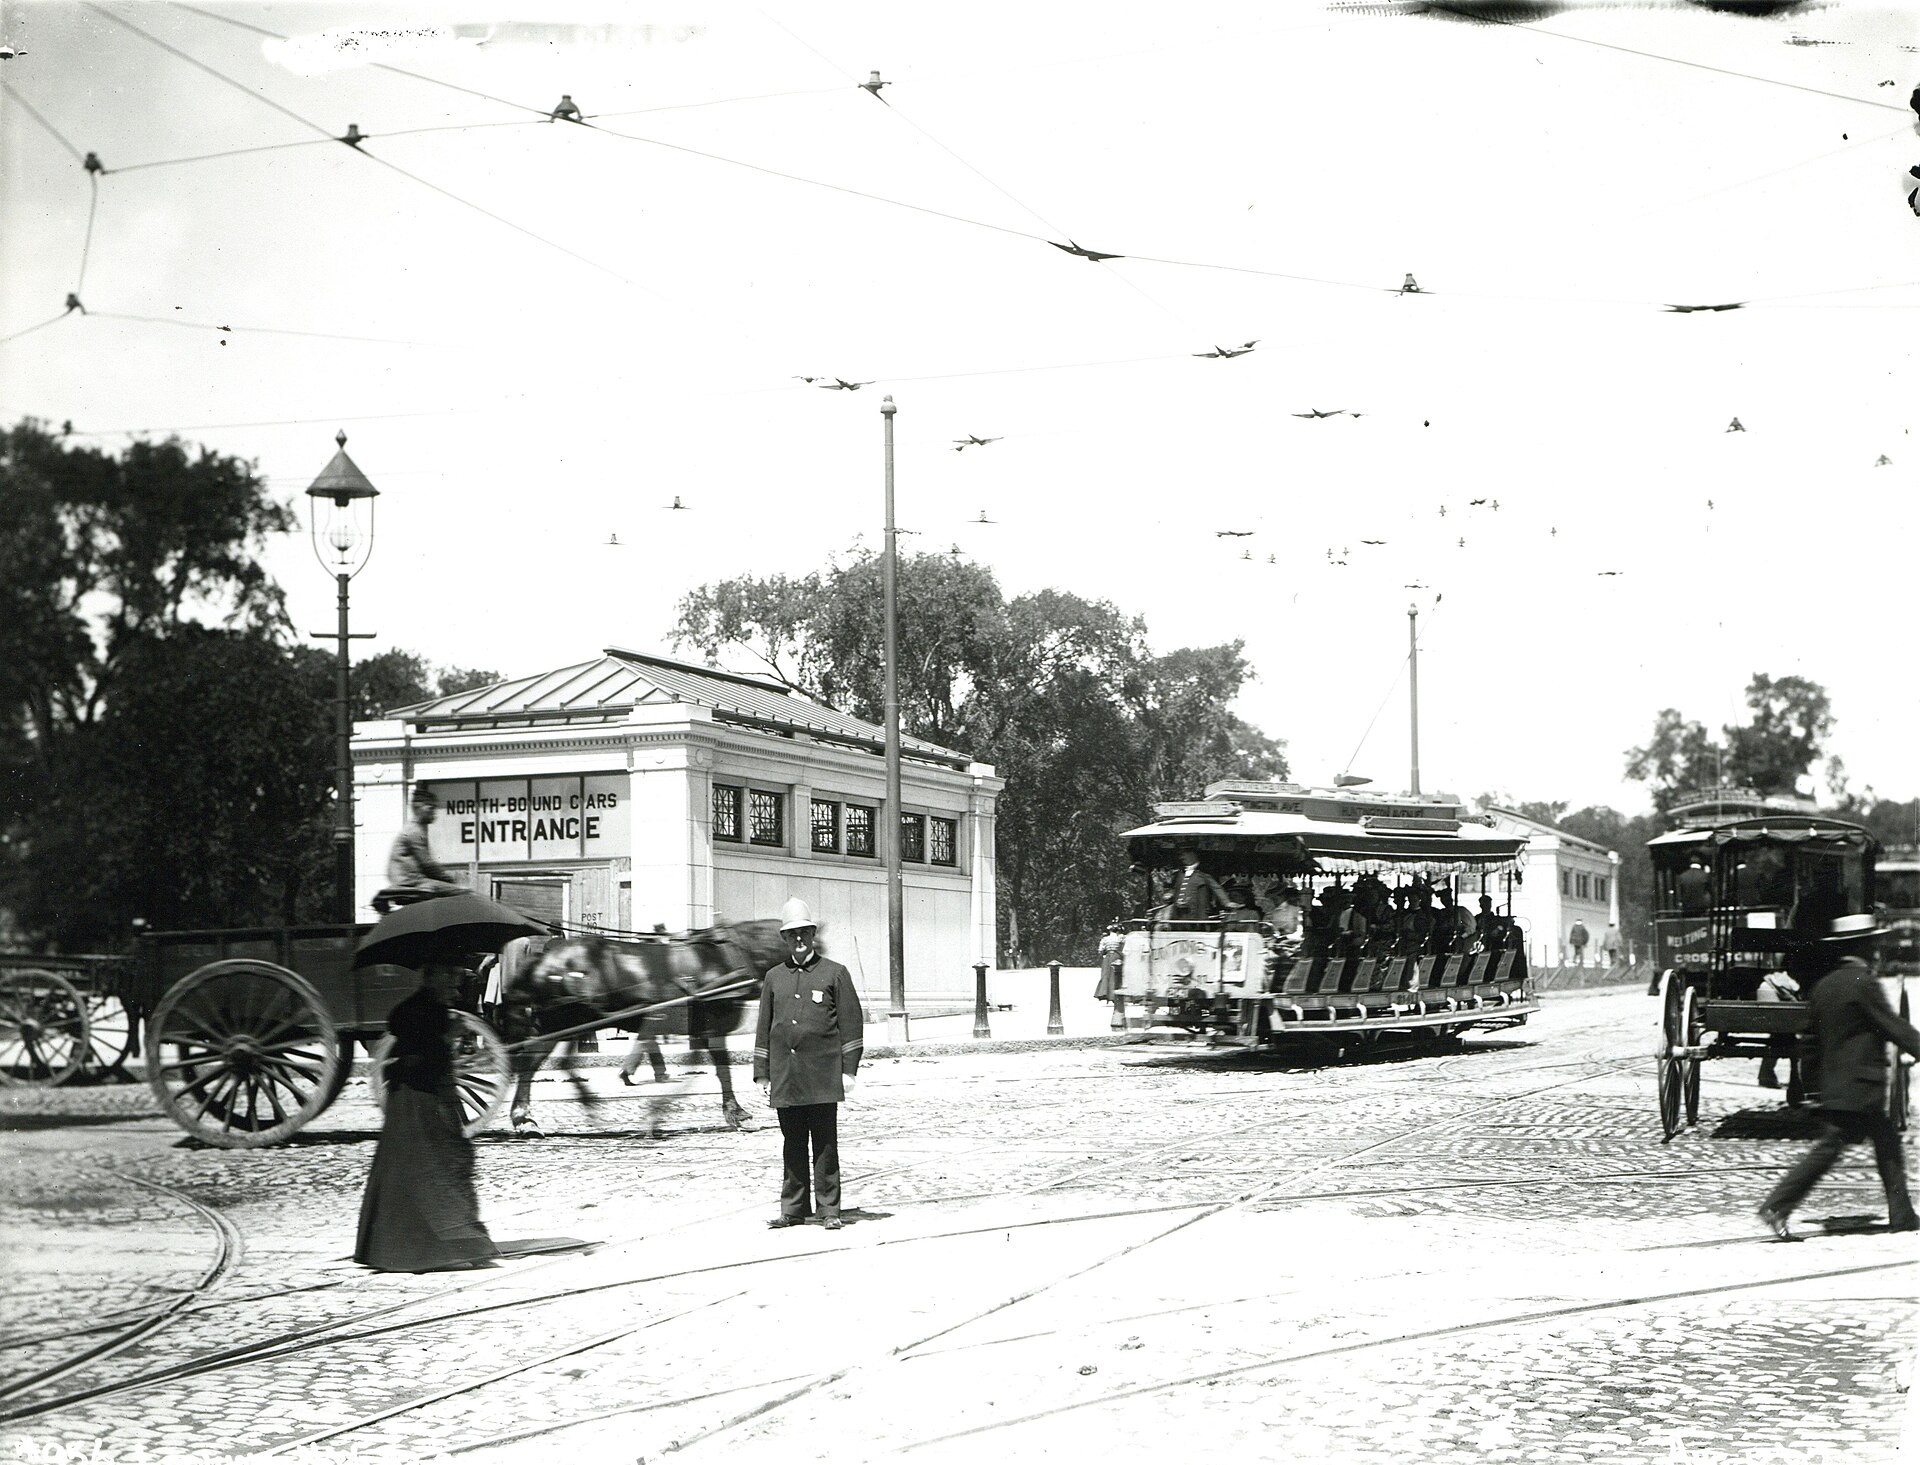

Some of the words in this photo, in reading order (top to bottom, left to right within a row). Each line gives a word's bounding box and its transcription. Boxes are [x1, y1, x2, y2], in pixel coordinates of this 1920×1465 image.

[446, 795, 562, 815] NORTH-BOUND
[569, 793, 617, 810] CARS
[461, 817, 600, 843] ENTRANCE
[581, 912, 603, 922] POST
